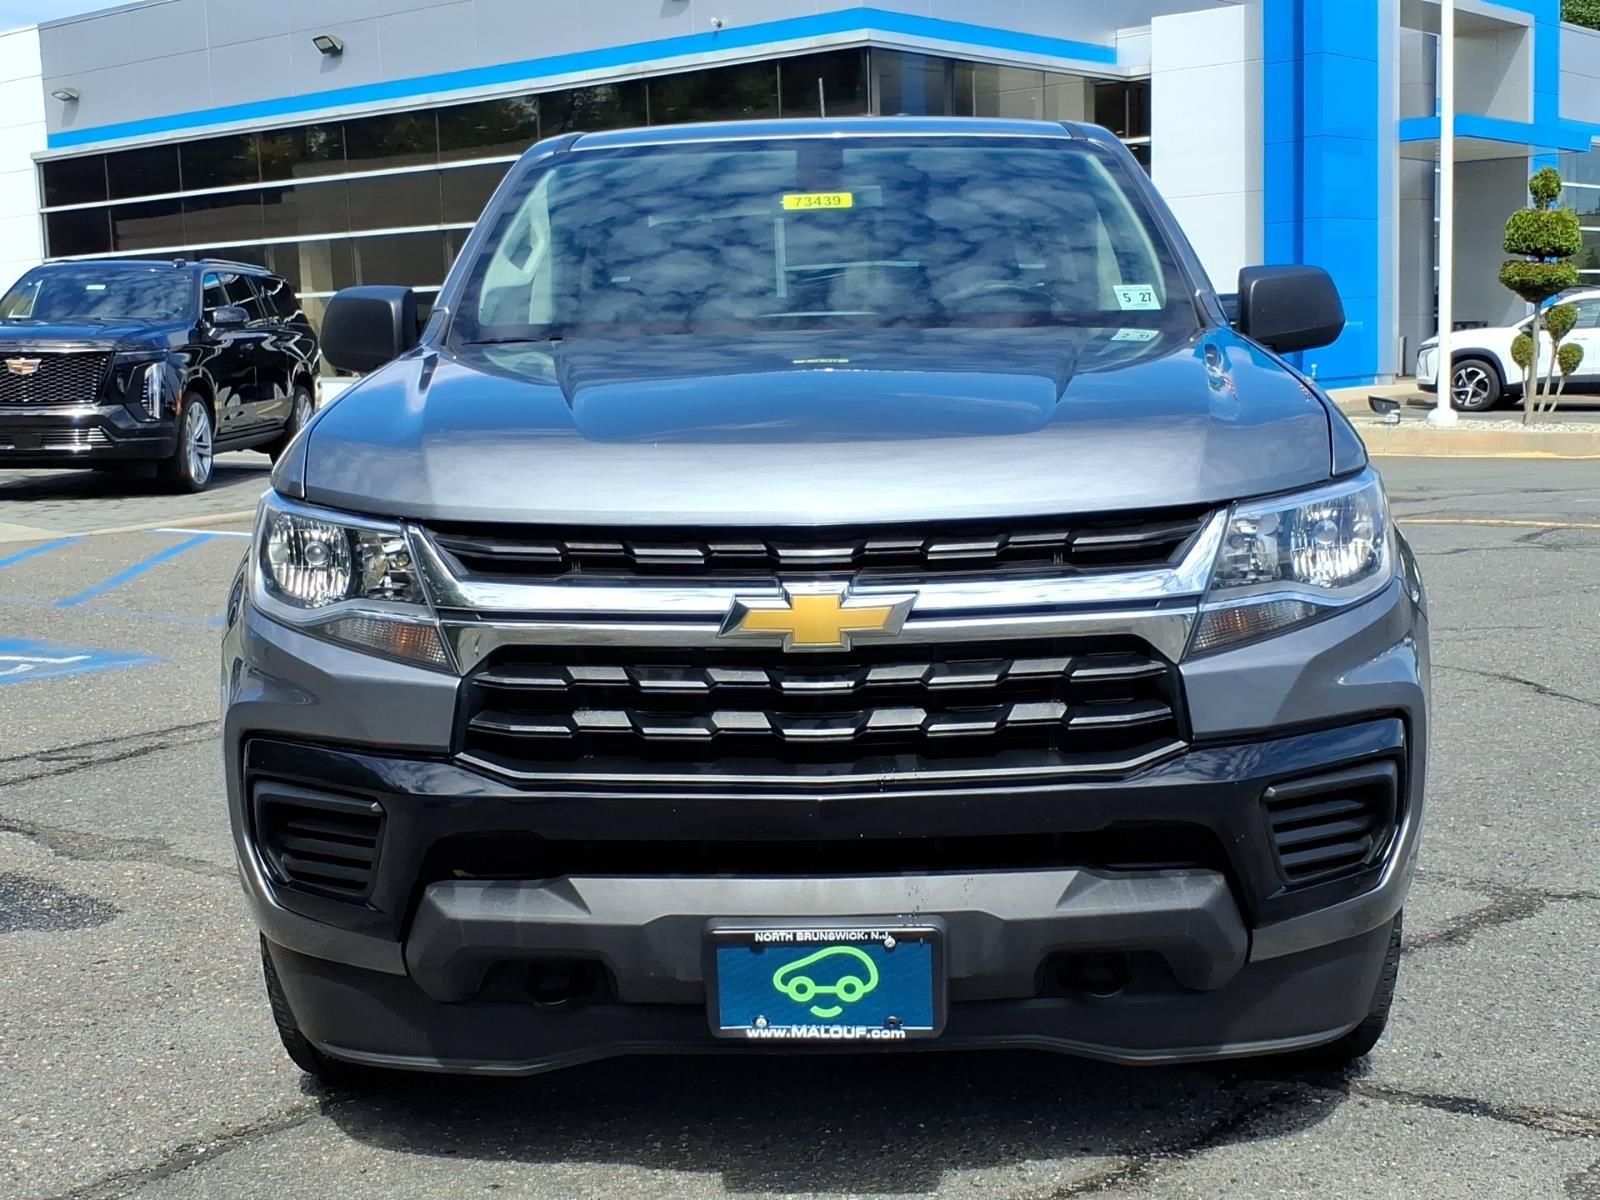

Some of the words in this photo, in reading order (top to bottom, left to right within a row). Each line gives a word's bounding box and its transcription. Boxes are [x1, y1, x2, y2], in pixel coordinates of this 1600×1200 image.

[793, 195, 841, 207] 73439
[1123, 293, 1131, 302] 5
[1139, 292, 1151, 302] 27
[755, 931, 793, 942] NORTH
[746, 1024, 905, 1039] www.MALOUF.com
